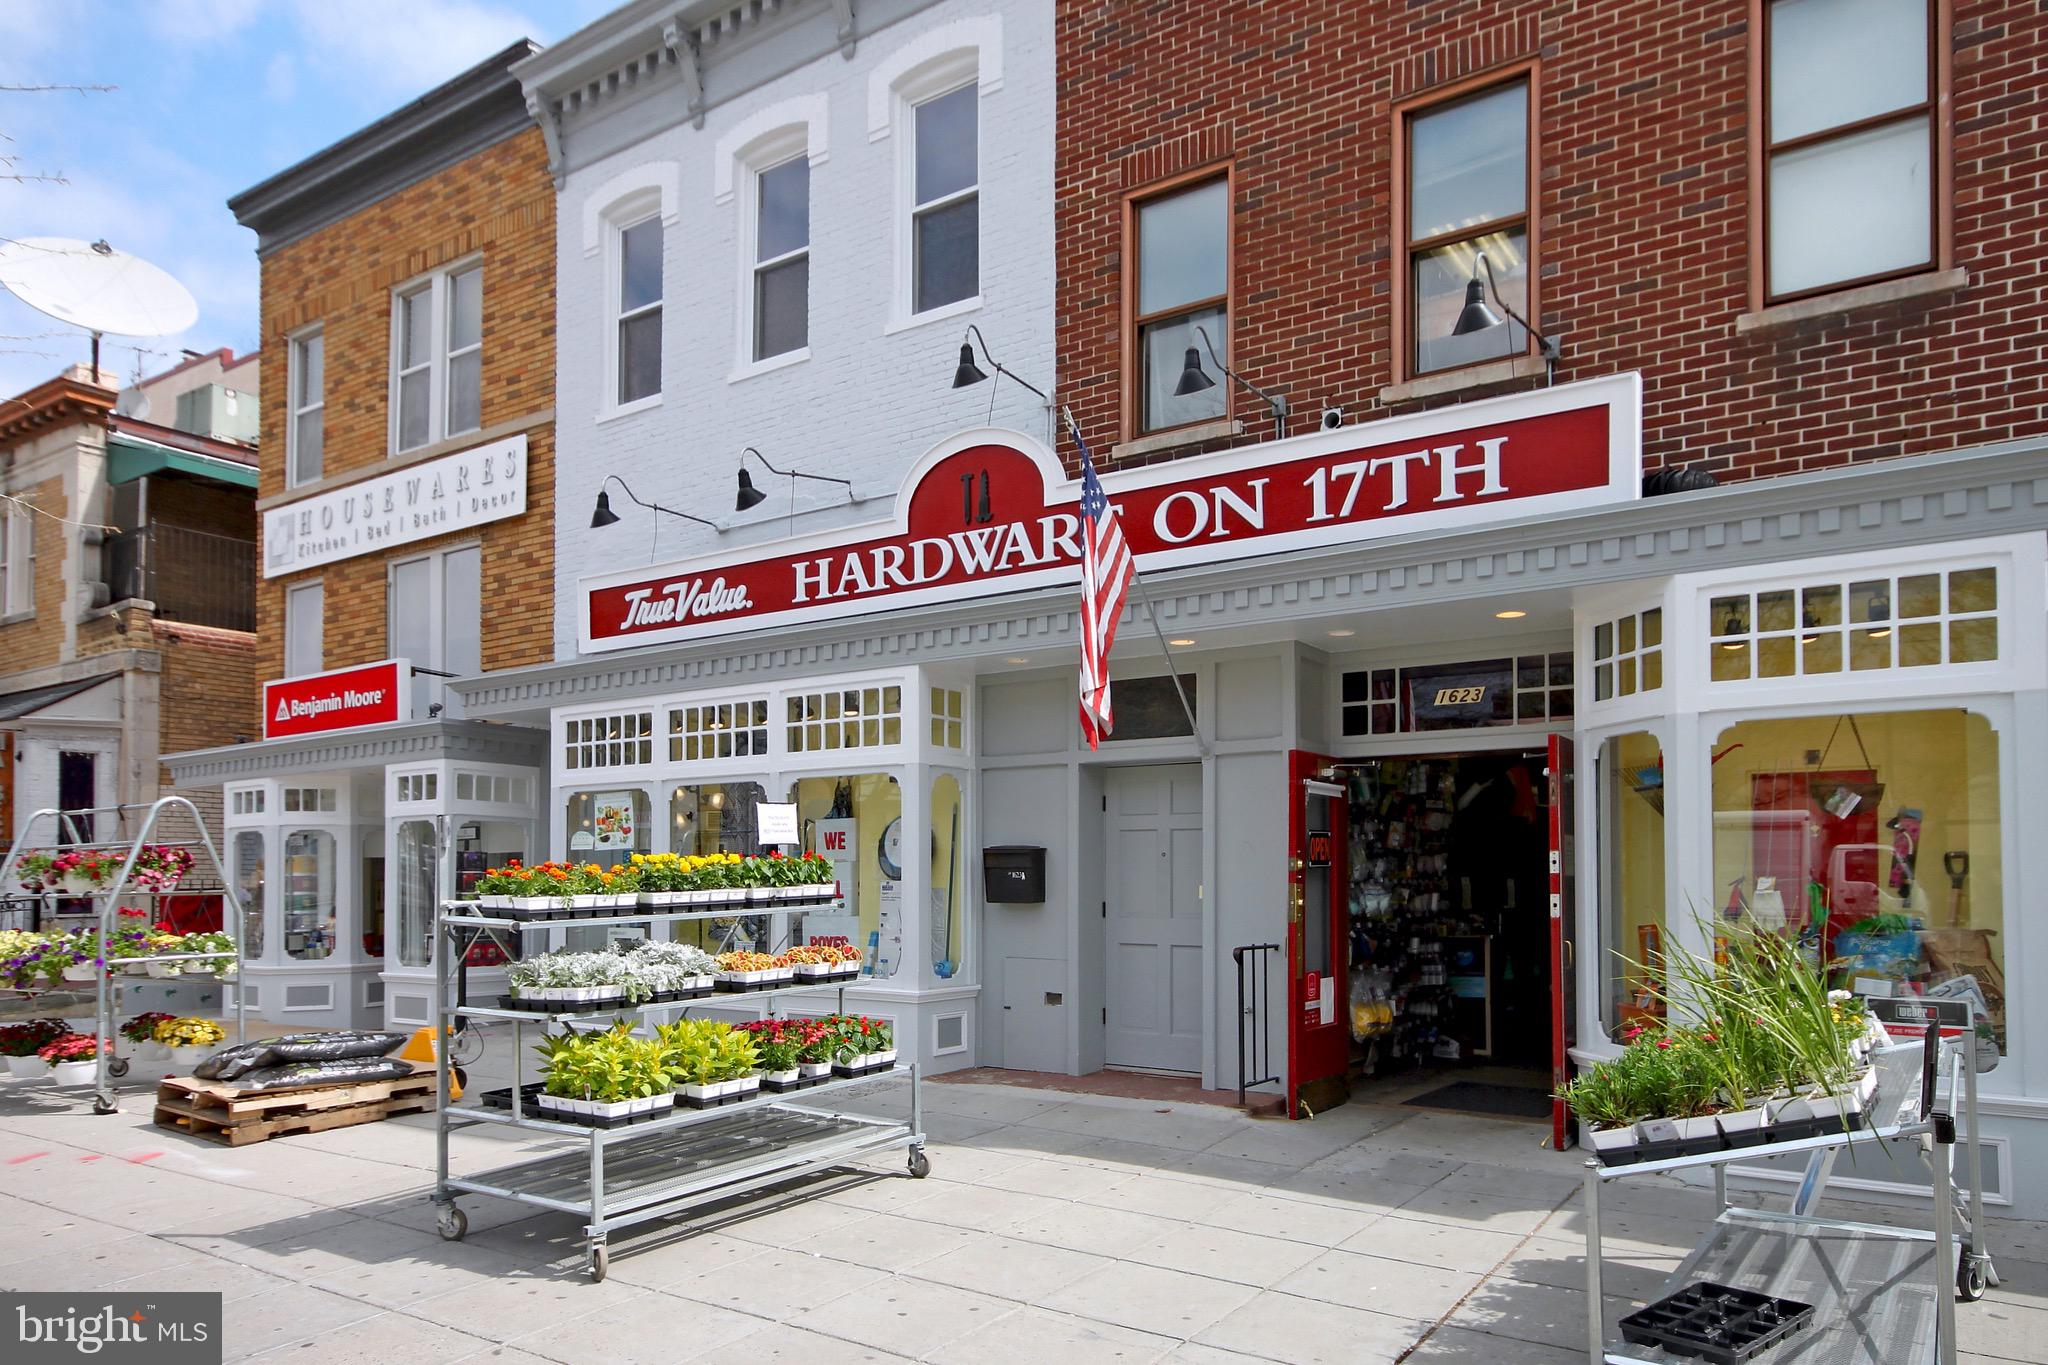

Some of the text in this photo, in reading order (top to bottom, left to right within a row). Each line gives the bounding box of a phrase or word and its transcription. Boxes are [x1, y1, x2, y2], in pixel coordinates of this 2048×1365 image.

[299, 450, 517, 536] HOUSEWARES
[298, 489, 516, 558] Kitchen Bed Bath Decor
[619, 582, 675, 631] True
[791, 502, 1124, 603] HARDWAR
[1152, 477, 1270, 543] ON
[1303, 436, 1509, 523] 17TH
[291, 692, 342, 718] Benjamin
[1439, 688, 1482, 704] 1623
[824, 831, 846, 850] WE
[1311, 837, 1330, 861] OPEN
[1898, 1005, 1927, 1018] weber
